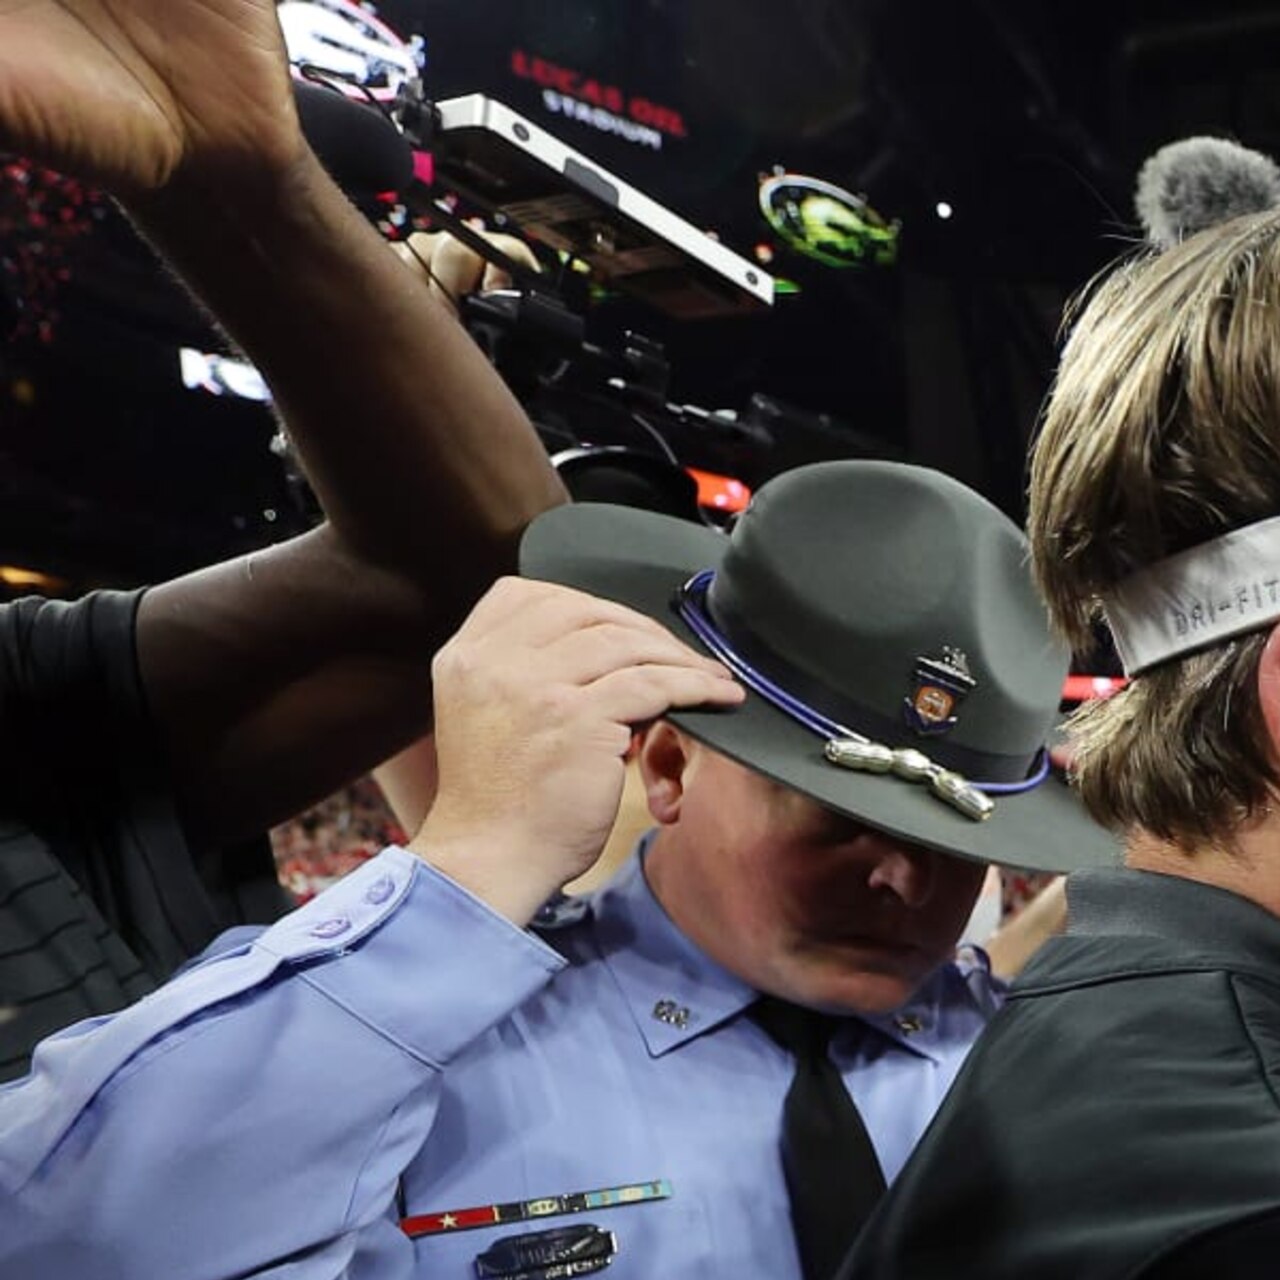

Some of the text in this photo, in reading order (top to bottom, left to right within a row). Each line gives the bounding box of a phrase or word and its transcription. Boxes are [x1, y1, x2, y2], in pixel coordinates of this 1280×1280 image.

[511, 50, 688, 137] LUCAS OIL
[542, 89, 663, 150] STADIUM
[1172, 579, 1280, 637] DRI-FIT
